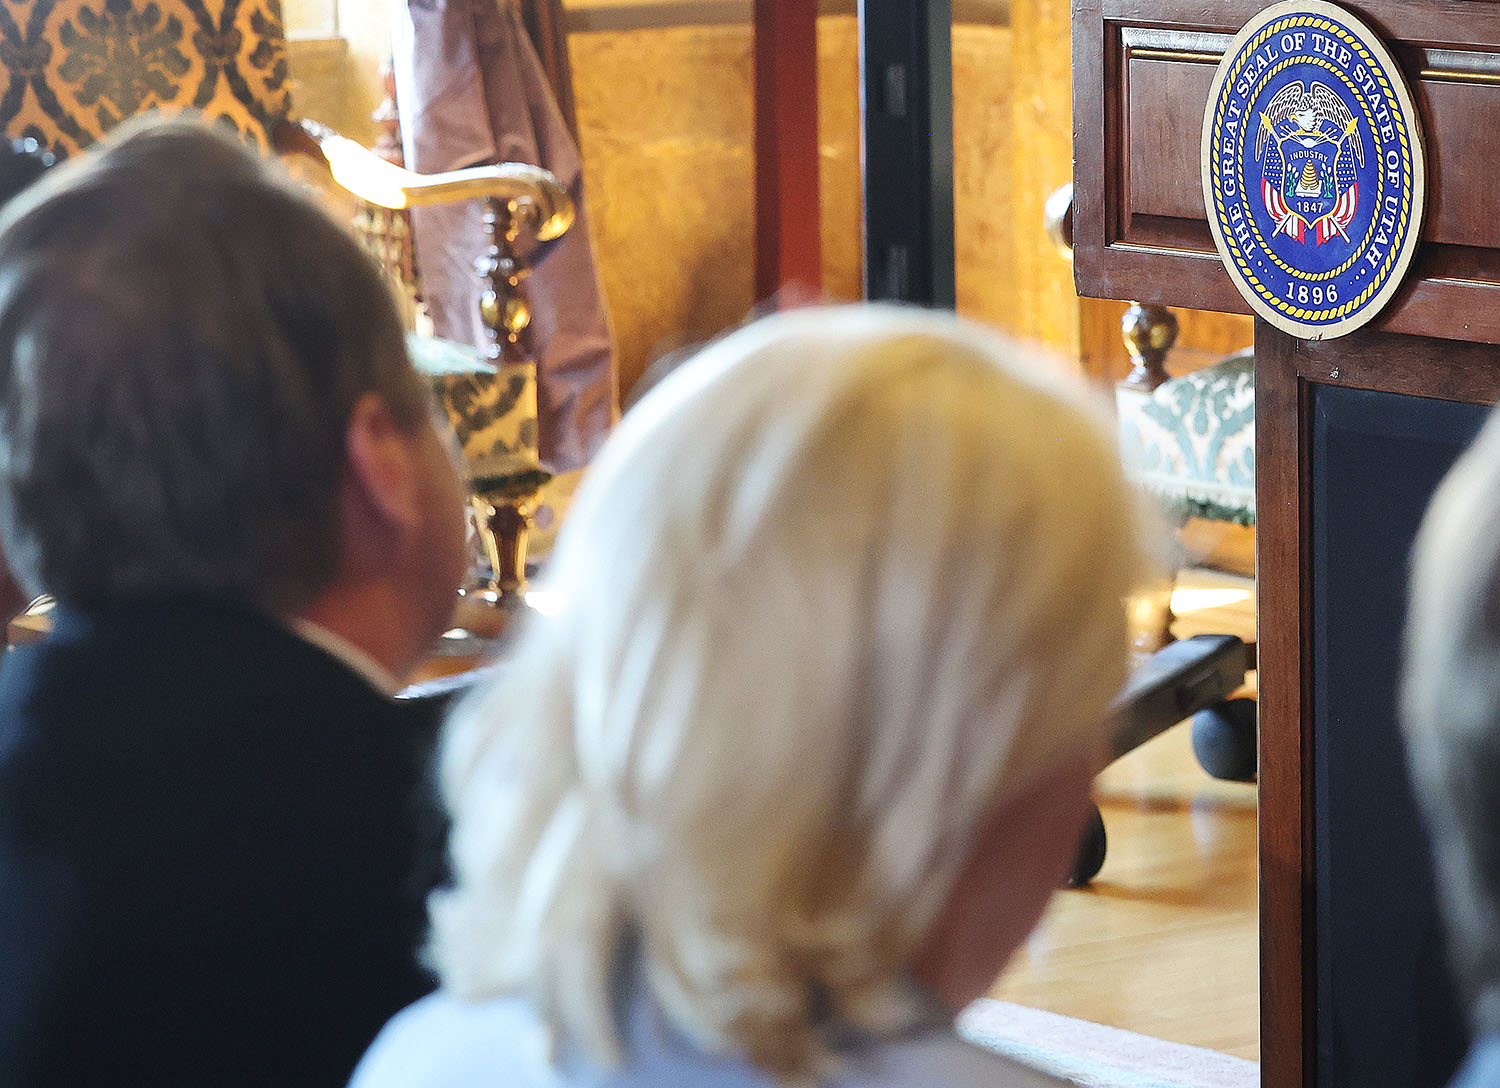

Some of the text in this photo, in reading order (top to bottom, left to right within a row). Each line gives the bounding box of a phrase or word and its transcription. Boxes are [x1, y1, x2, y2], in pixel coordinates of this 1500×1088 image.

[1222, 32, 1400, 269] THE GREAT SEAL OF THE STATE OF UTAH
[1289, 150, 1329, 163] INDUSTRY
[1296, 201, 1324, 214] 1847
[1285, 281, 1338, 305] 1896
